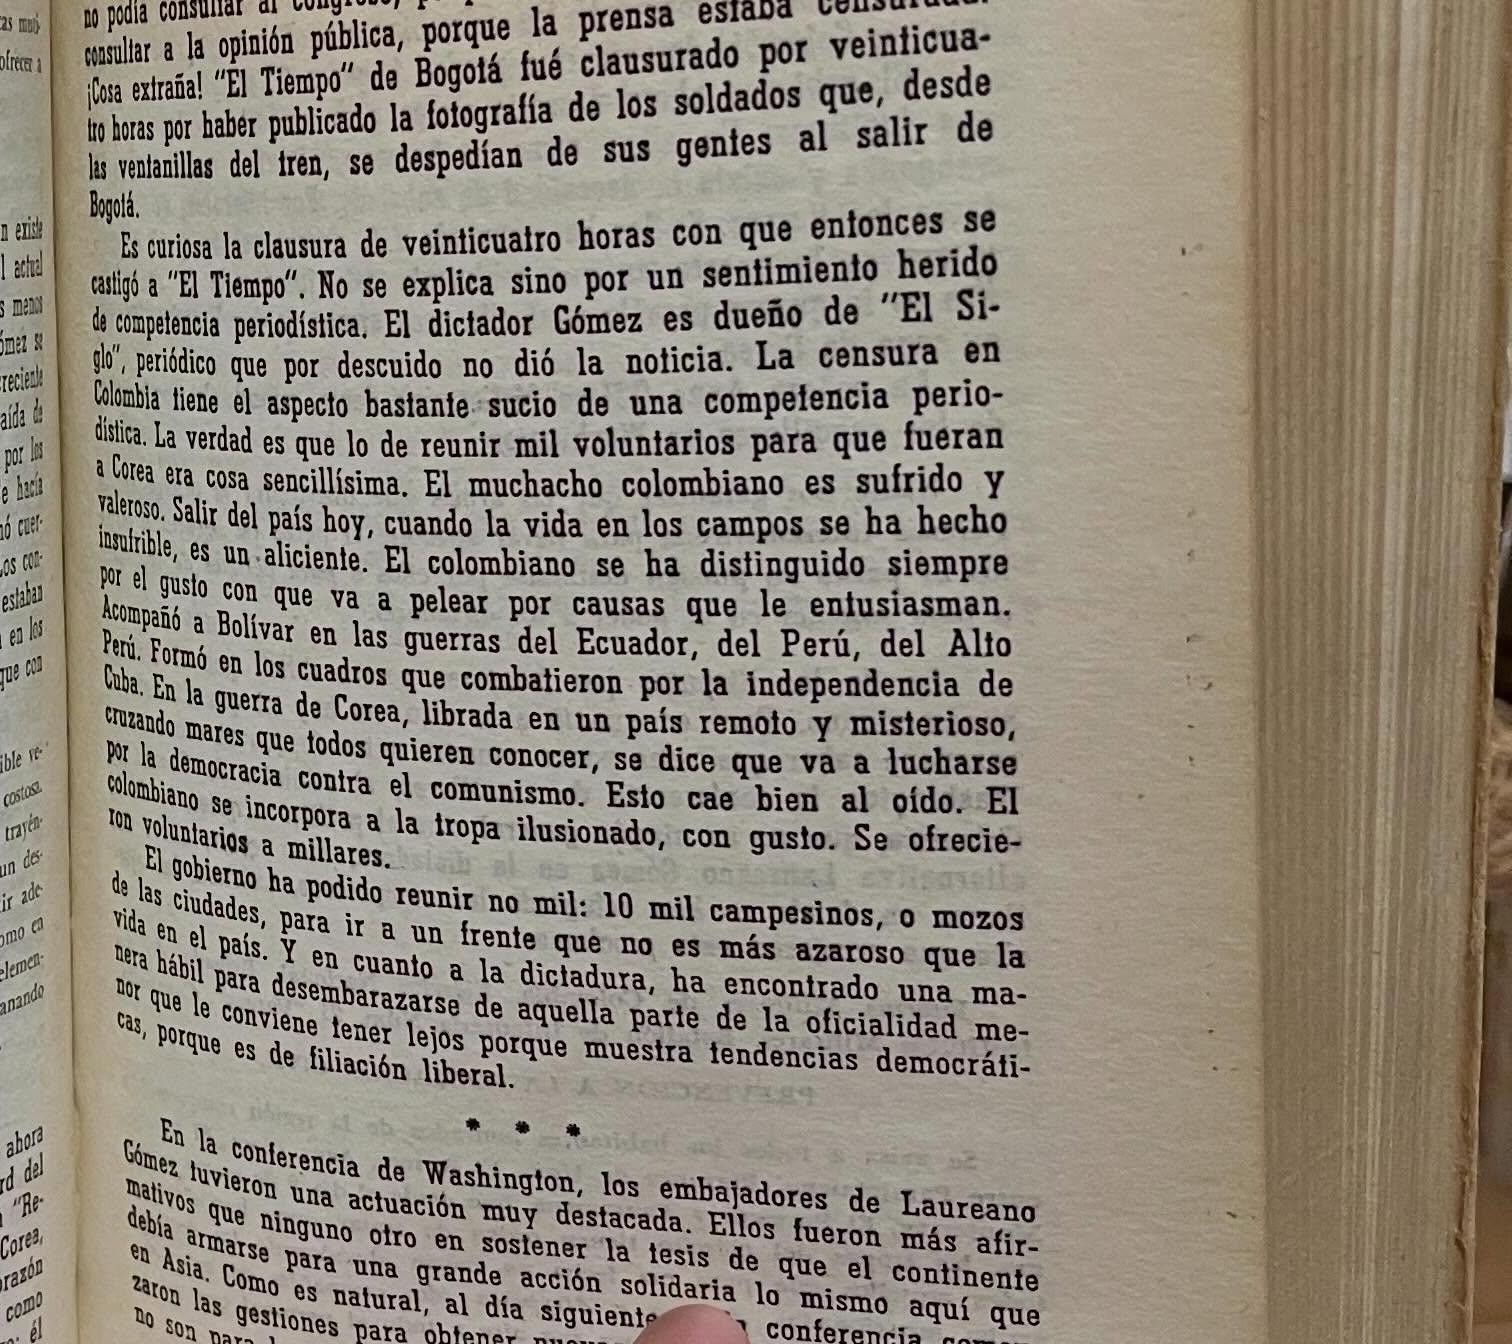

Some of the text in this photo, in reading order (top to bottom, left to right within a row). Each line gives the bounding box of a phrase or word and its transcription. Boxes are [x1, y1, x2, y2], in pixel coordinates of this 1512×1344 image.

[83, 6, 99, 30] no
[91, 268, 139, 303] castigó
[148, 277, 159, 298] a
[316, 269, 349, 300] No
[362, 276, 387, 299] se
[402, 266, 495, 305] explica
[511, 265, 567, 295] sino
[583, 268, 630, 301] por
[645, 266, 685, 291] un
[702, 252, 879, 289] sentimiento
[895, 243, 999, 280] herido
[102, 595, 1012, 663] Acompañó a Bolívar en las guerras del Ecuador, del Perú, del Alto
[107, 770, 1023, 856] colombiano se incorpora a la tropa ilusionado, con gusto. Se ofrecie-
[113, 943, 1030, 1042] nera hábil para desembarazarse de aquella parte de la oficialidad me-
[23, 1151, 44, 1184] del
[123, 1138, 1039, 1257] Gómez tuvieron una actuación muy destacada. Ellos fueron más afir-
